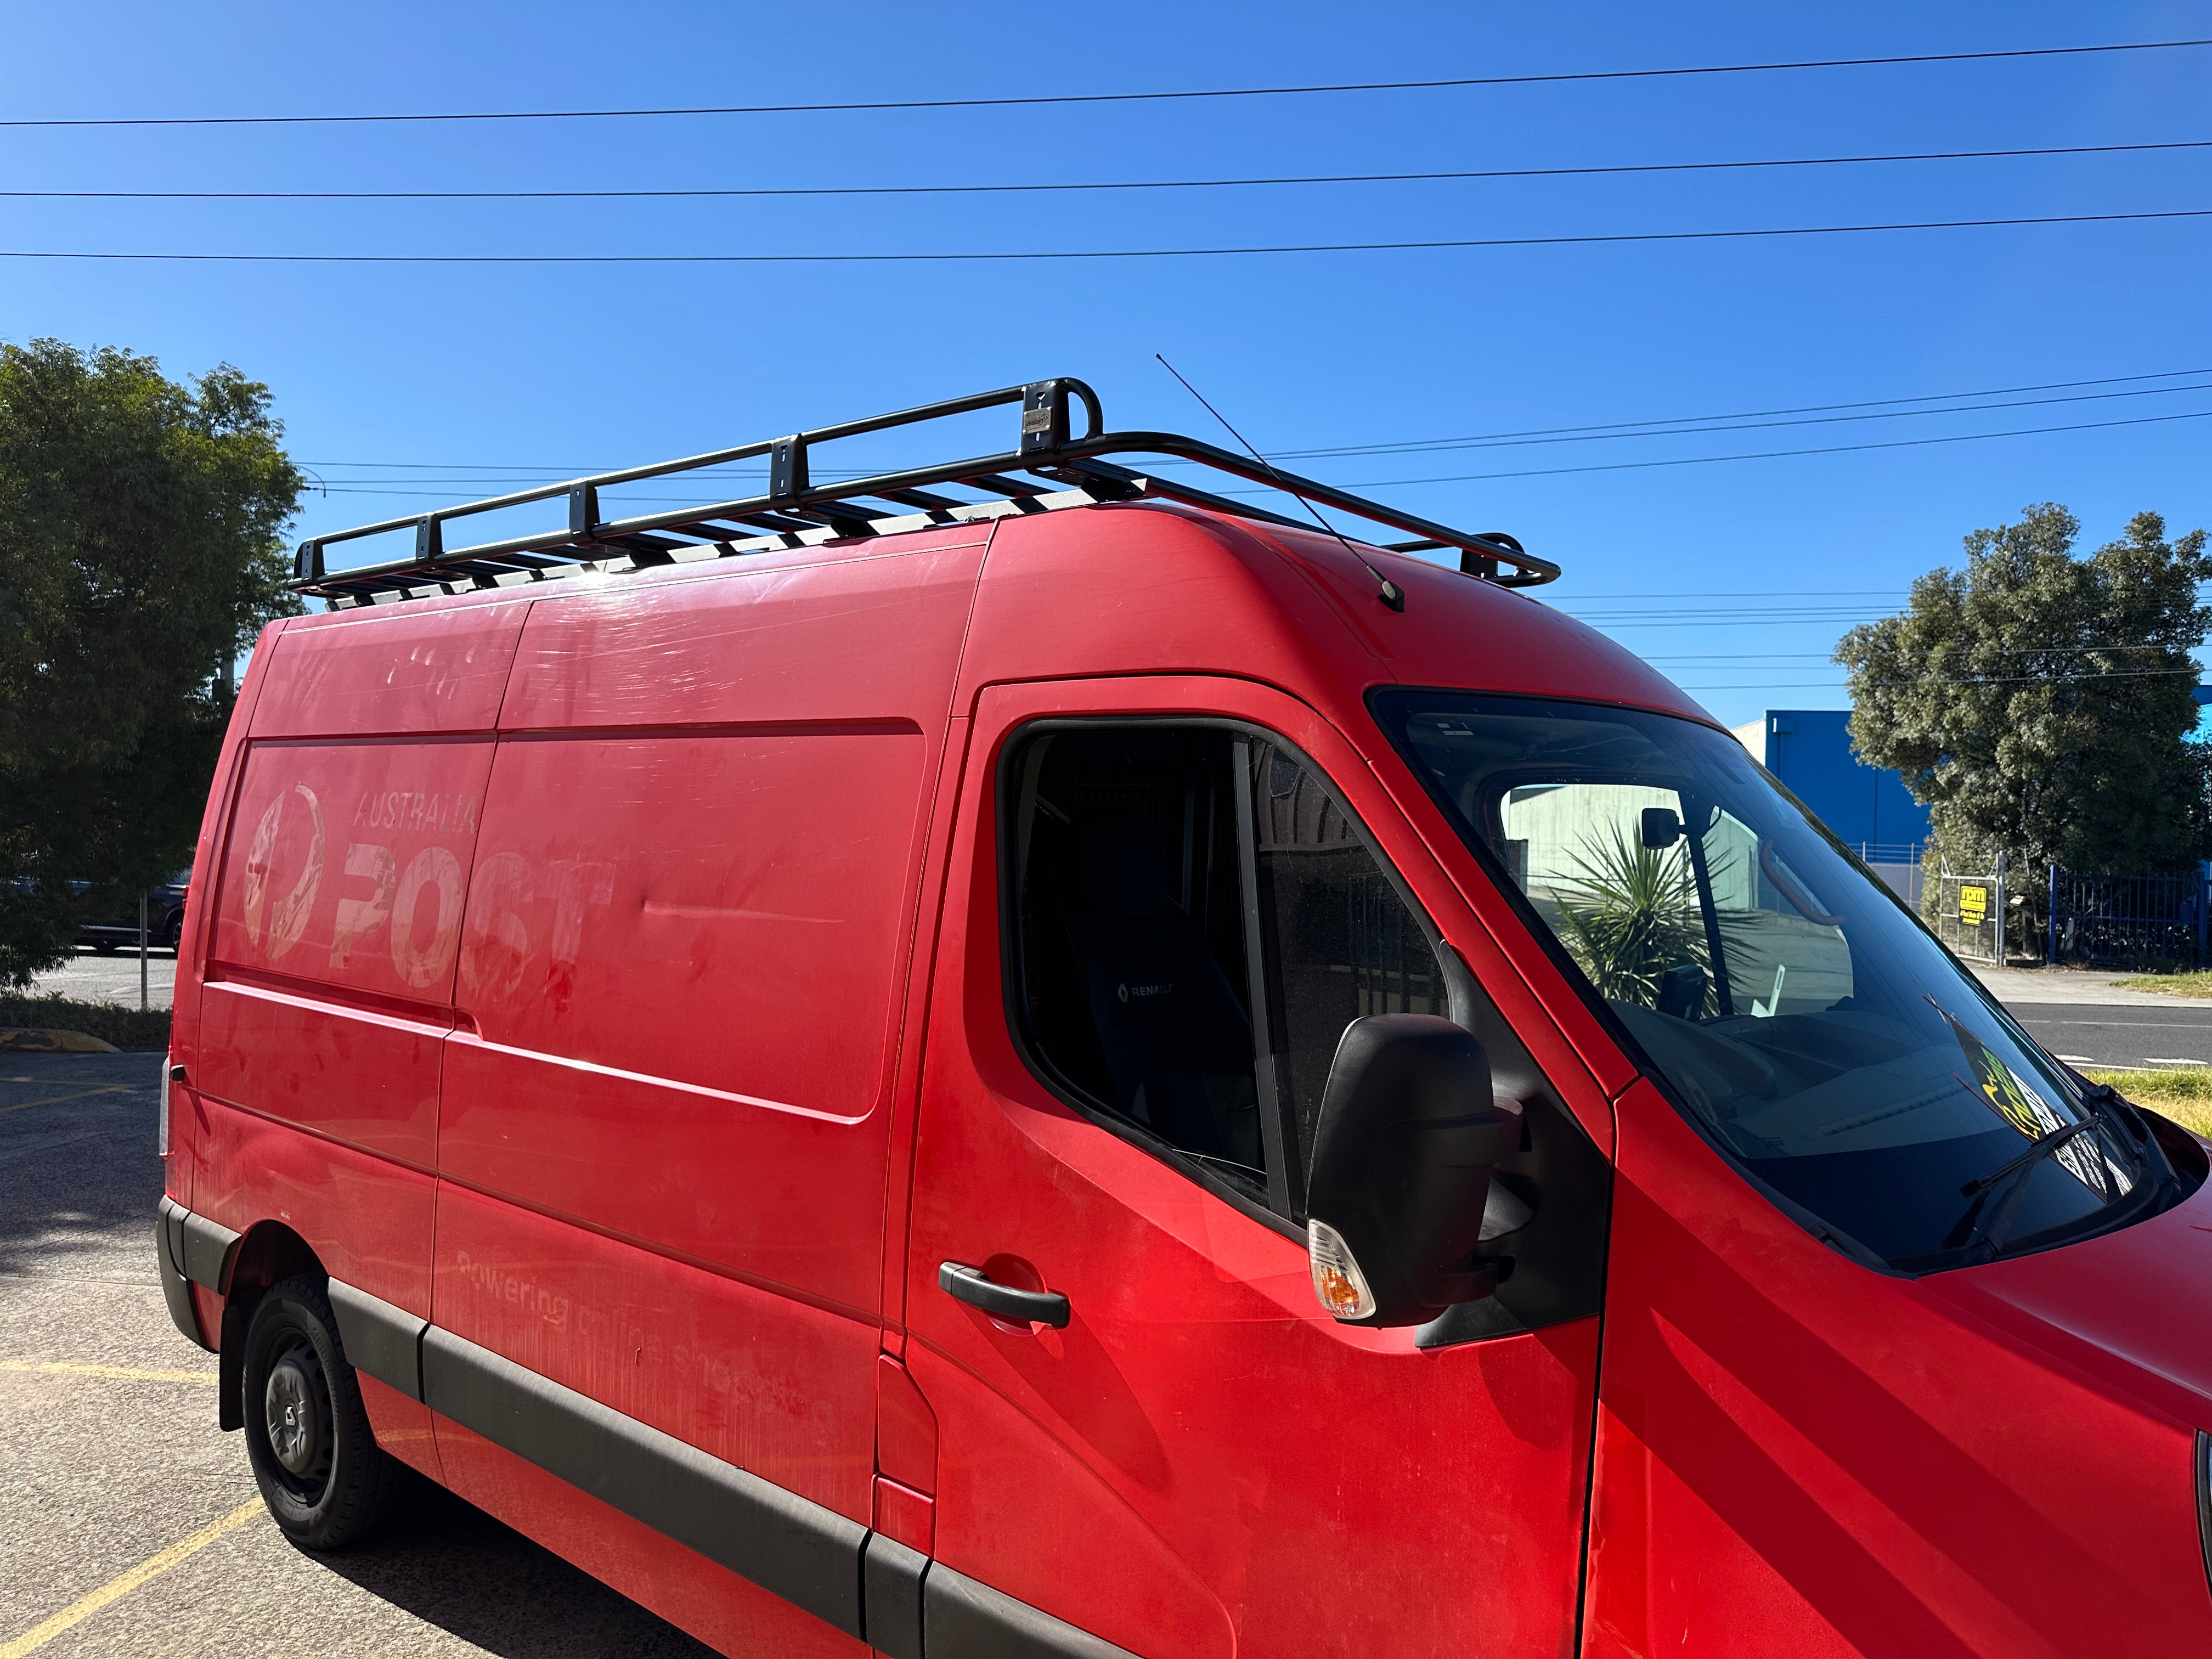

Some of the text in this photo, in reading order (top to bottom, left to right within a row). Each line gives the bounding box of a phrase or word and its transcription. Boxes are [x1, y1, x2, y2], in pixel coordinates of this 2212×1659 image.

[353, 791, 478, 833] AUSTRALIA
[1962, 888, 1985, 902] rpm
[329, 843, 617, 1007] POST
[1131, 984, 1173, 997] RENAULT
[456, 1250, 569, 1334] Powering
[674, 1340, 834, 1447] shoppg
